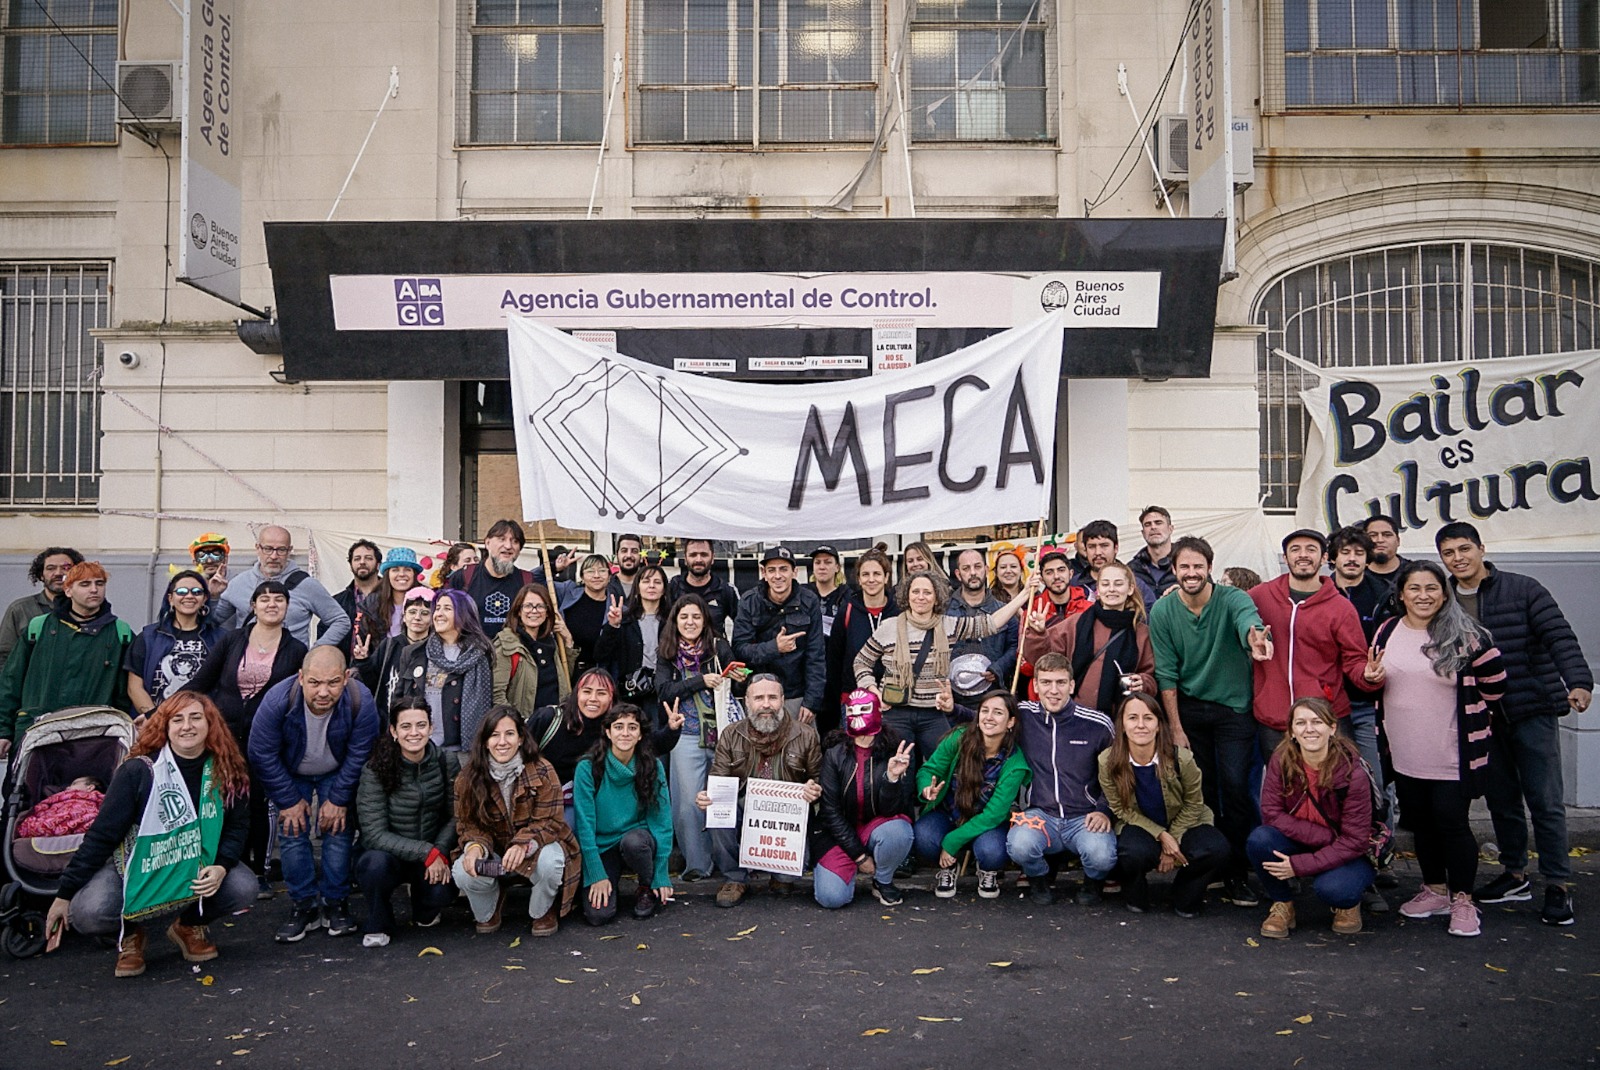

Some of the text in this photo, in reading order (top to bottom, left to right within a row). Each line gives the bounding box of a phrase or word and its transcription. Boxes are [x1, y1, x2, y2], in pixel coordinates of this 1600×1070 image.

[200, 34, 214, 146] Agencia
[217, 14, 231, 156] de Control.
[1194, 44, 1203, 150] Agencia
[1205, 105, 1214, 141] de
[210, 220, 238, 244] Buenos
[210, 233, 229, 252] Aires
[210, 245, 236, 267] Ciudad
[1075, 280, 1125, 292] Buenos
[500, 287, 938, 313] Agencia Gubernamental de Control.
[1074, 292, 1107, 304] Aires
[1073, 304, 1121, 316] Ciudad
[886, 343, 912, 351] CULTURA
[1329, 367, 1584, 467] Bailar
[788, 363, 1045, 511] MECA
[1439, 439, 1474, 469] es
[753, 800, 802, 815] LARRETA:
[748, 818, 801, 833] LA CULTURA
[759, 835, 787, 846] NO SE
[748, 846, 797, 861] CLAUSURA
